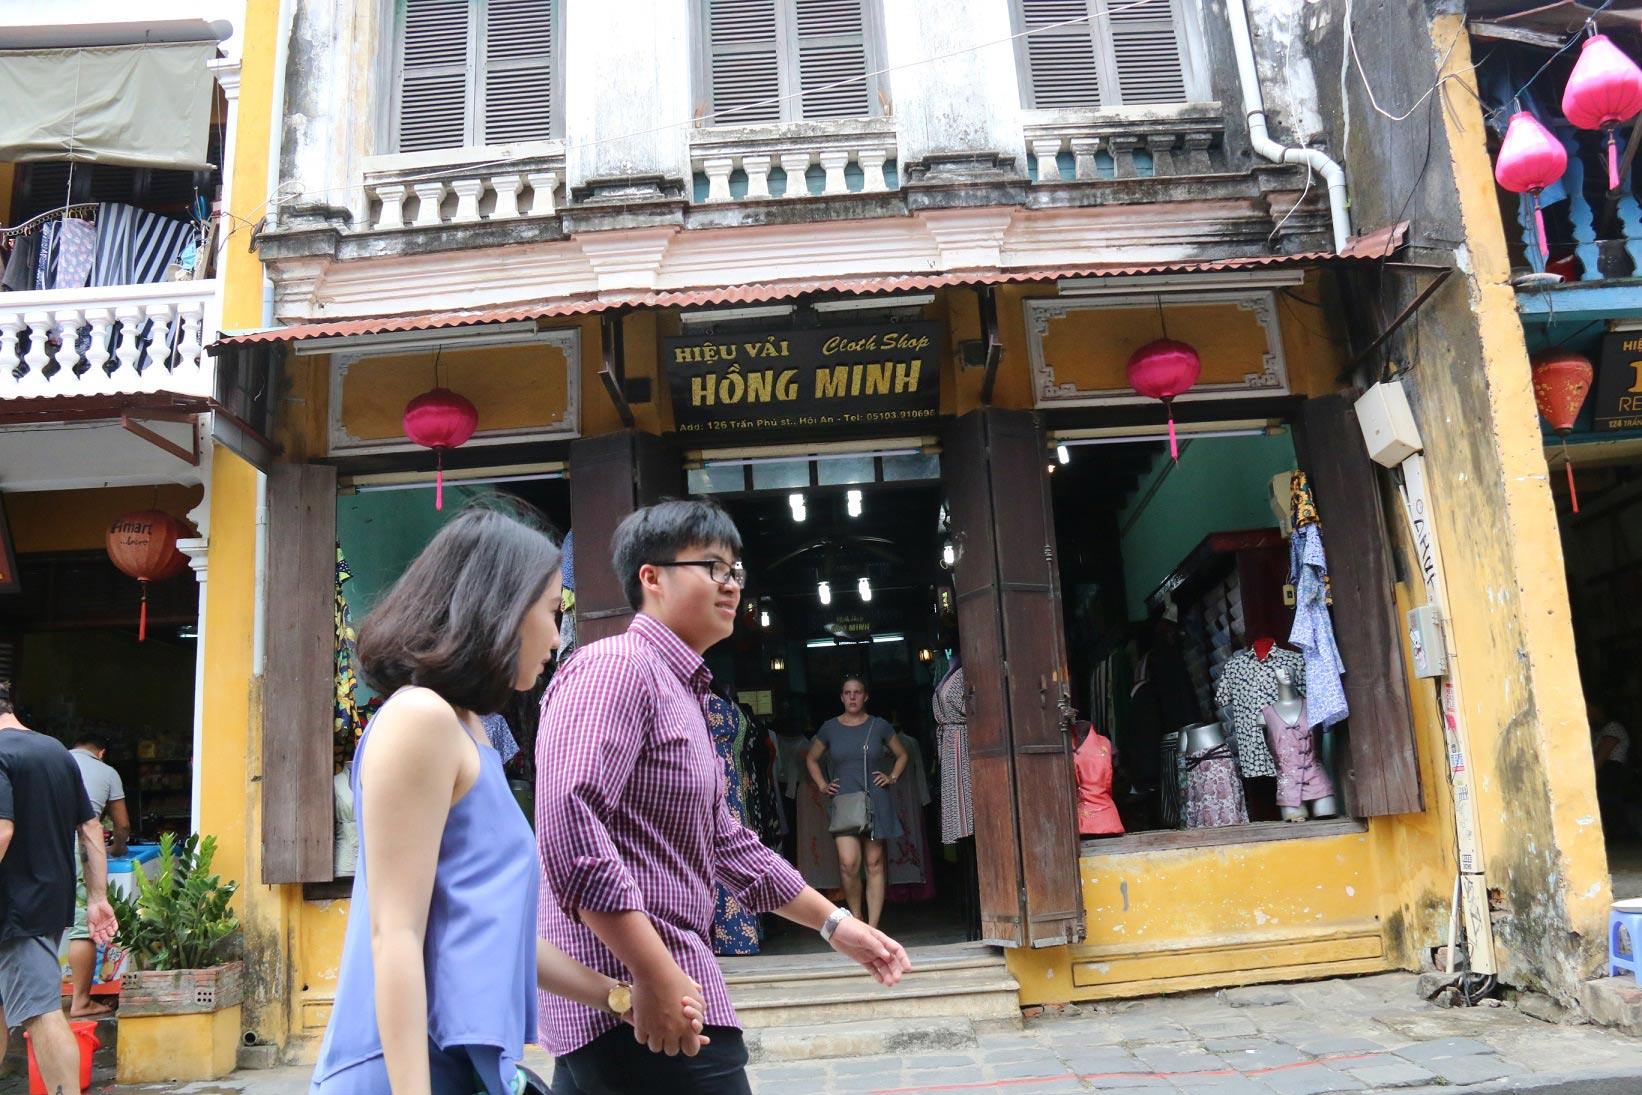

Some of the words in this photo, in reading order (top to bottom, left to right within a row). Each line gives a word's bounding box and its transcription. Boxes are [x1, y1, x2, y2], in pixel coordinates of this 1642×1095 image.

[674, 342, 737, 364] HIỆU
[744, 336, 790, 358] VẢI
[822, 334, 877, 355] Cloth
[880, 332, 930, 352] Shop
[691, 363, 799, 407] HỒNG
[814, 359, 922, 399] MINH
[679, 423, 704, 432] Add:
[707, 421, 727, 430] 126
